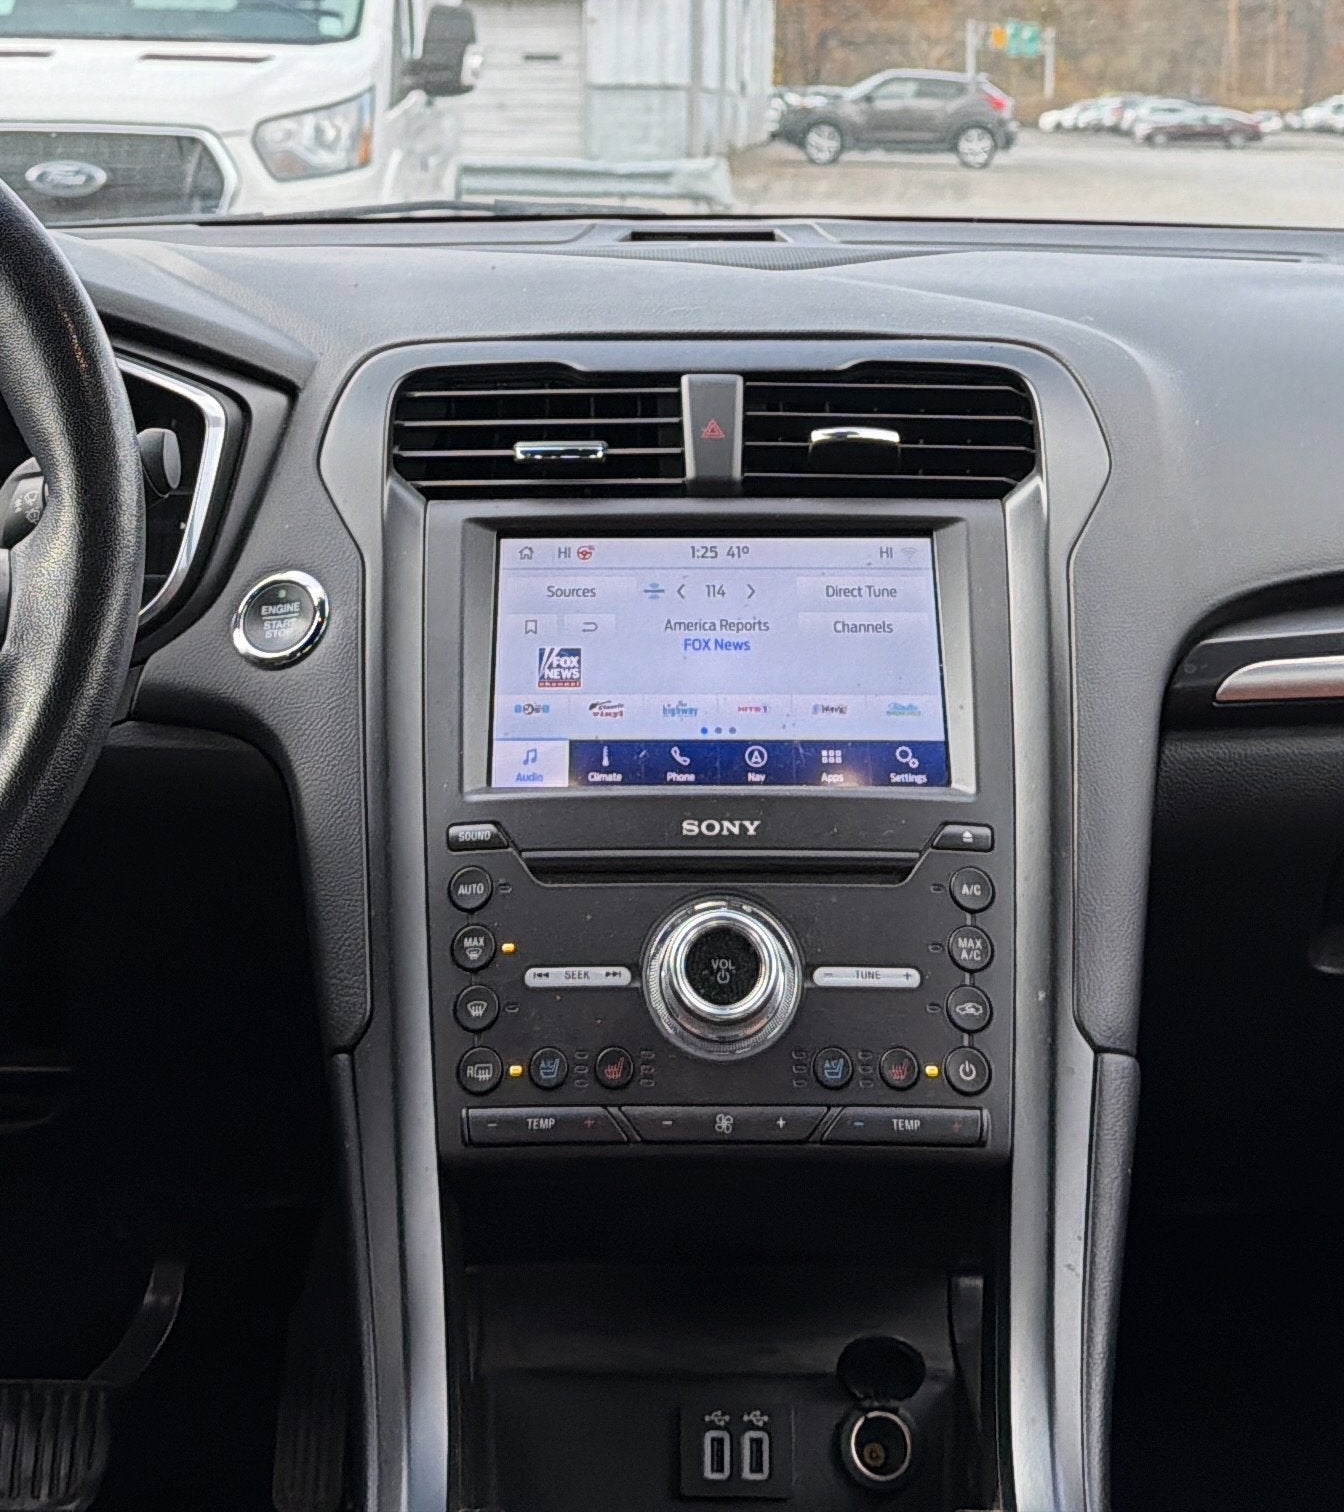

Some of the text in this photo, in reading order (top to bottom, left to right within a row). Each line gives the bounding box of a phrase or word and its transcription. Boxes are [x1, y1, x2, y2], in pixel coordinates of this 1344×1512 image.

[557, 546, 572, 559] HI
[690, 545, 719, 559] 1:25
[879, 546, 894, 559] HI
[546, 585, 597, 598] Sources
[704, 584, 727, 598] 114
[825, 584, 898, 598] Direct Tune
[260, 601, 301, 616] ENGINE
[263, 617, 298, 630] START
[664, 618, 770, 634] America Reports
[833, 620, 894, 634] Channels
[683, 638, 752, 652] FOX News
[552, 655, 580, 668] FOX
[543, 668, 580, 680] NEWS
[662, 703, 699, 718] highway
[515, 772, 544, 783] Audio
[587, 771, 623, 783] Climate
[666, 772, 696, 783] Phone
[747, 772, 766, 783] Nav
[821, 772, 844, 785] Apps
[889, 772, 928, 785] Settings
[681, 819, 762, 836] SONY
[458, 830, 492, 842] SOUND
[457, 883, 485, 896] AUTO
[961, 884, 982, 896] A/C
[463, 936, 485, 948] MAX
[958, 937, 983, 950] MAX
[960, 949, 982, 961] A/C
[711, 958, 736, 970] VOL
[564, 969, 591, 980] SEEK
[855, 970, 881, 980] TUNE
[824, 1059, 839, 1069] A/C
[466, 1066, 475, 1078] R
[526, 1118, 556, 1130] TEMP
[892, 1119, 921, 1131] TEMP
